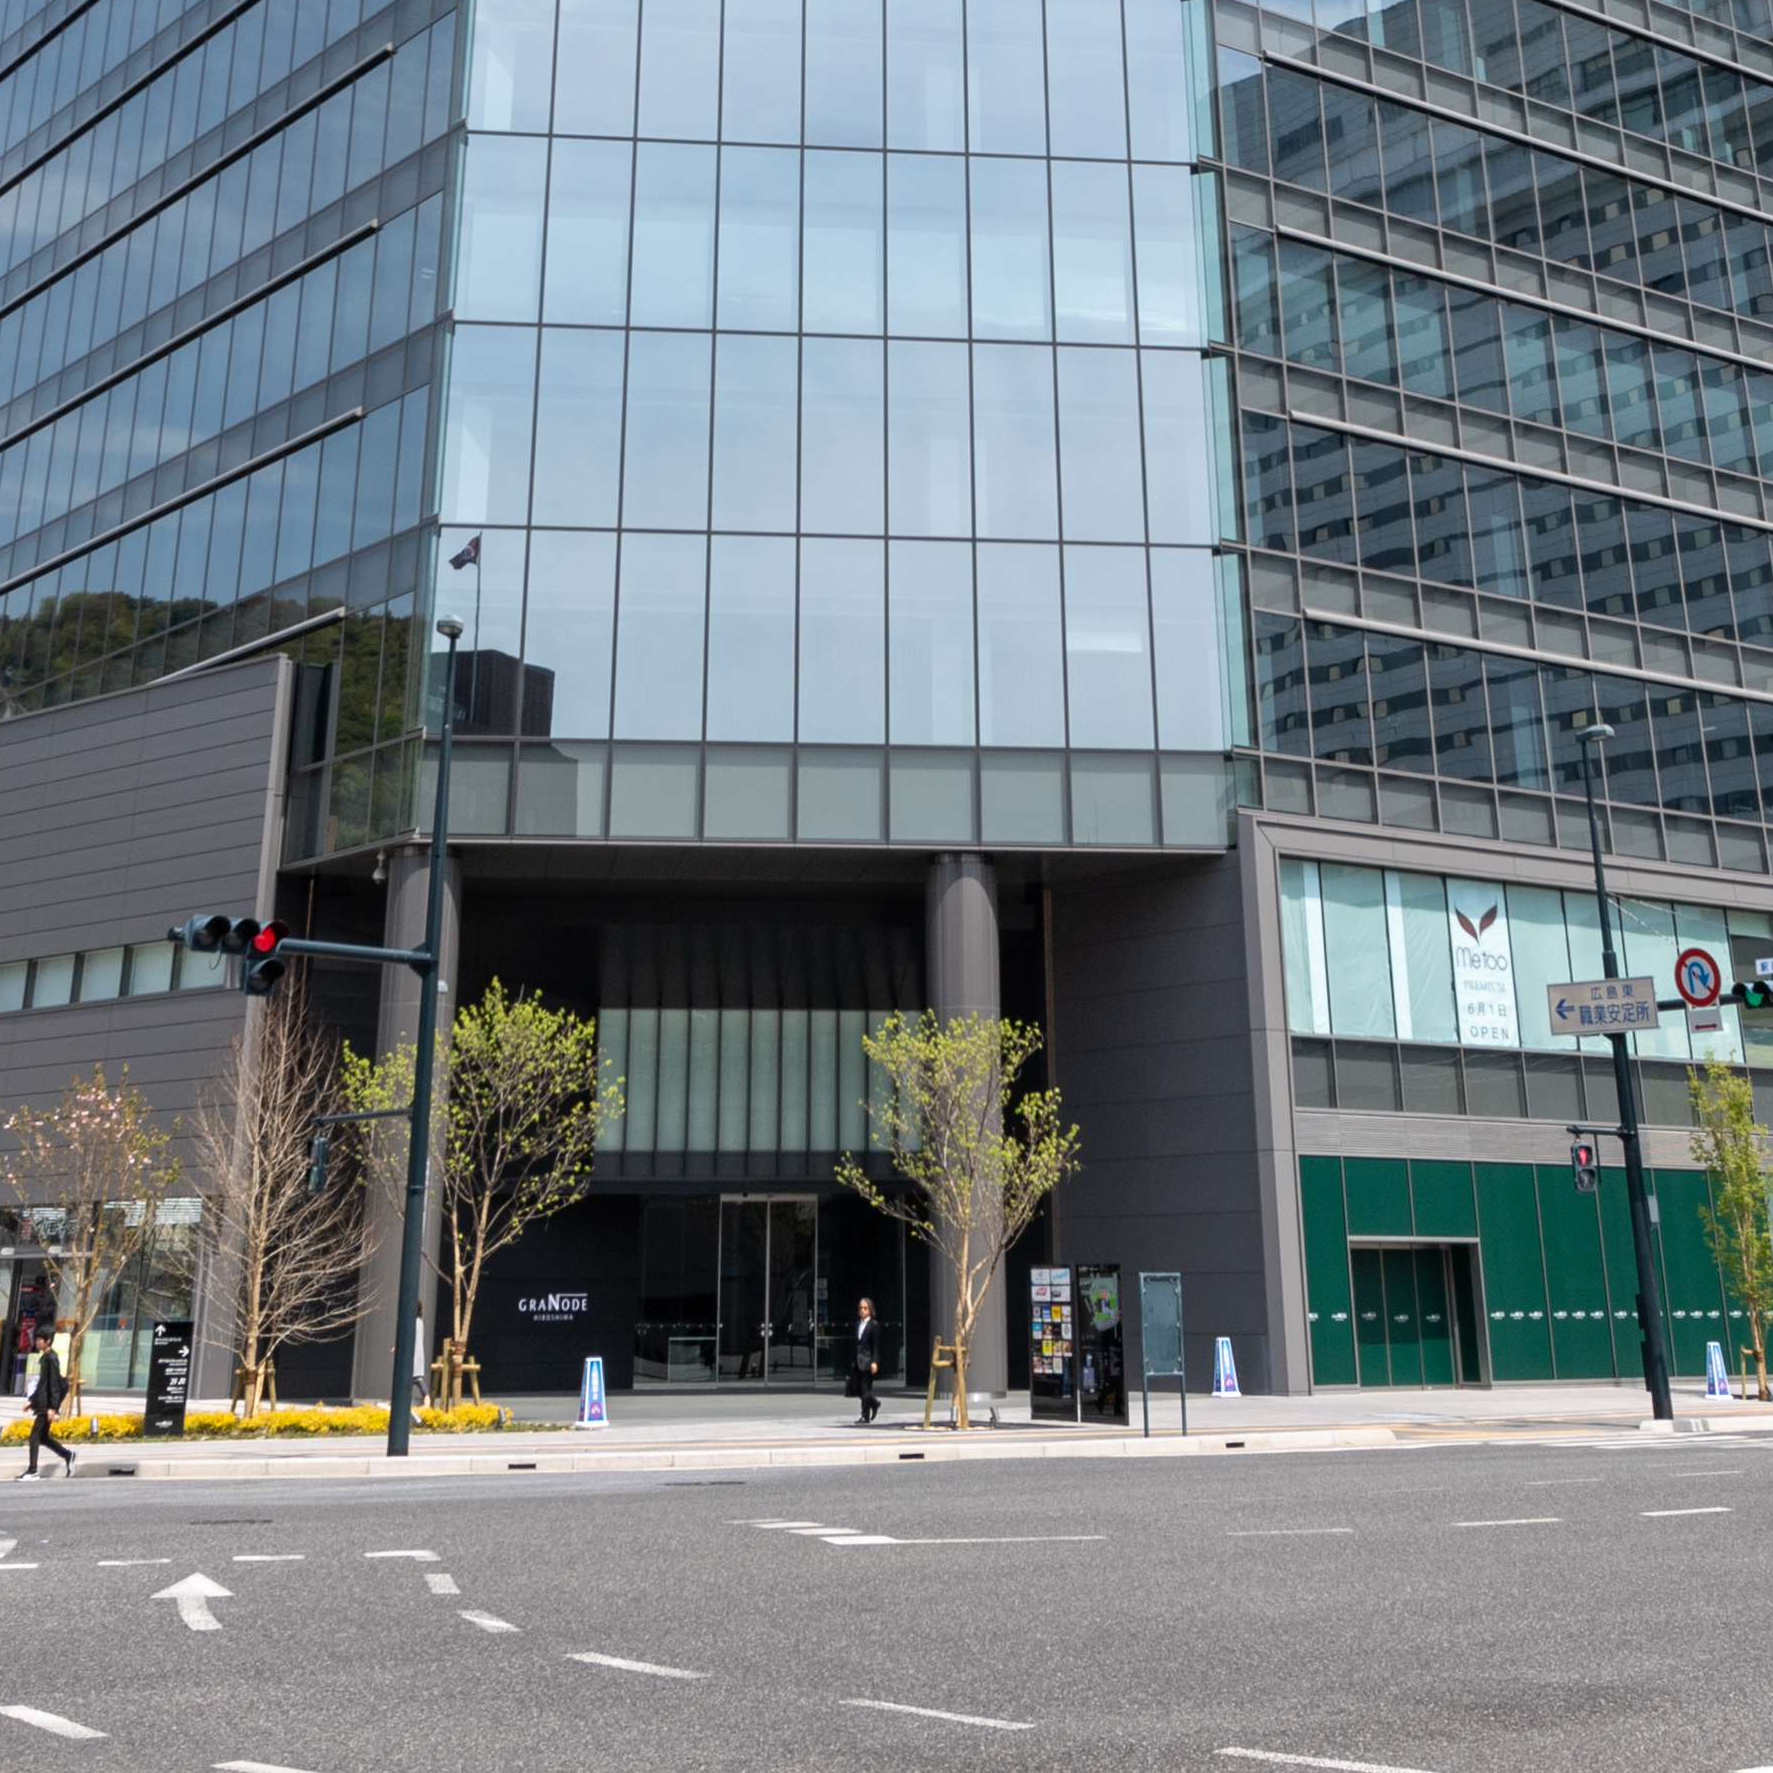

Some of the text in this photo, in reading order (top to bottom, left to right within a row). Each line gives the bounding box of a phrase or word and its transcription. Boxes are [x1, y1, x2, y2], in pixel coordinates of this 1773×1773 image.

[1463, 979, 1507, 993] PREMIUM
[1589, 984, 1635, 1001] 広島東
[1467, 1001, 1508, 1018] 6月1日
[1578, 1000, 1651, 1025] 職業安定所
[1469, 1026, 1510, 1040] OPEN
[518, 1293, 588, 1312] GRANODE
